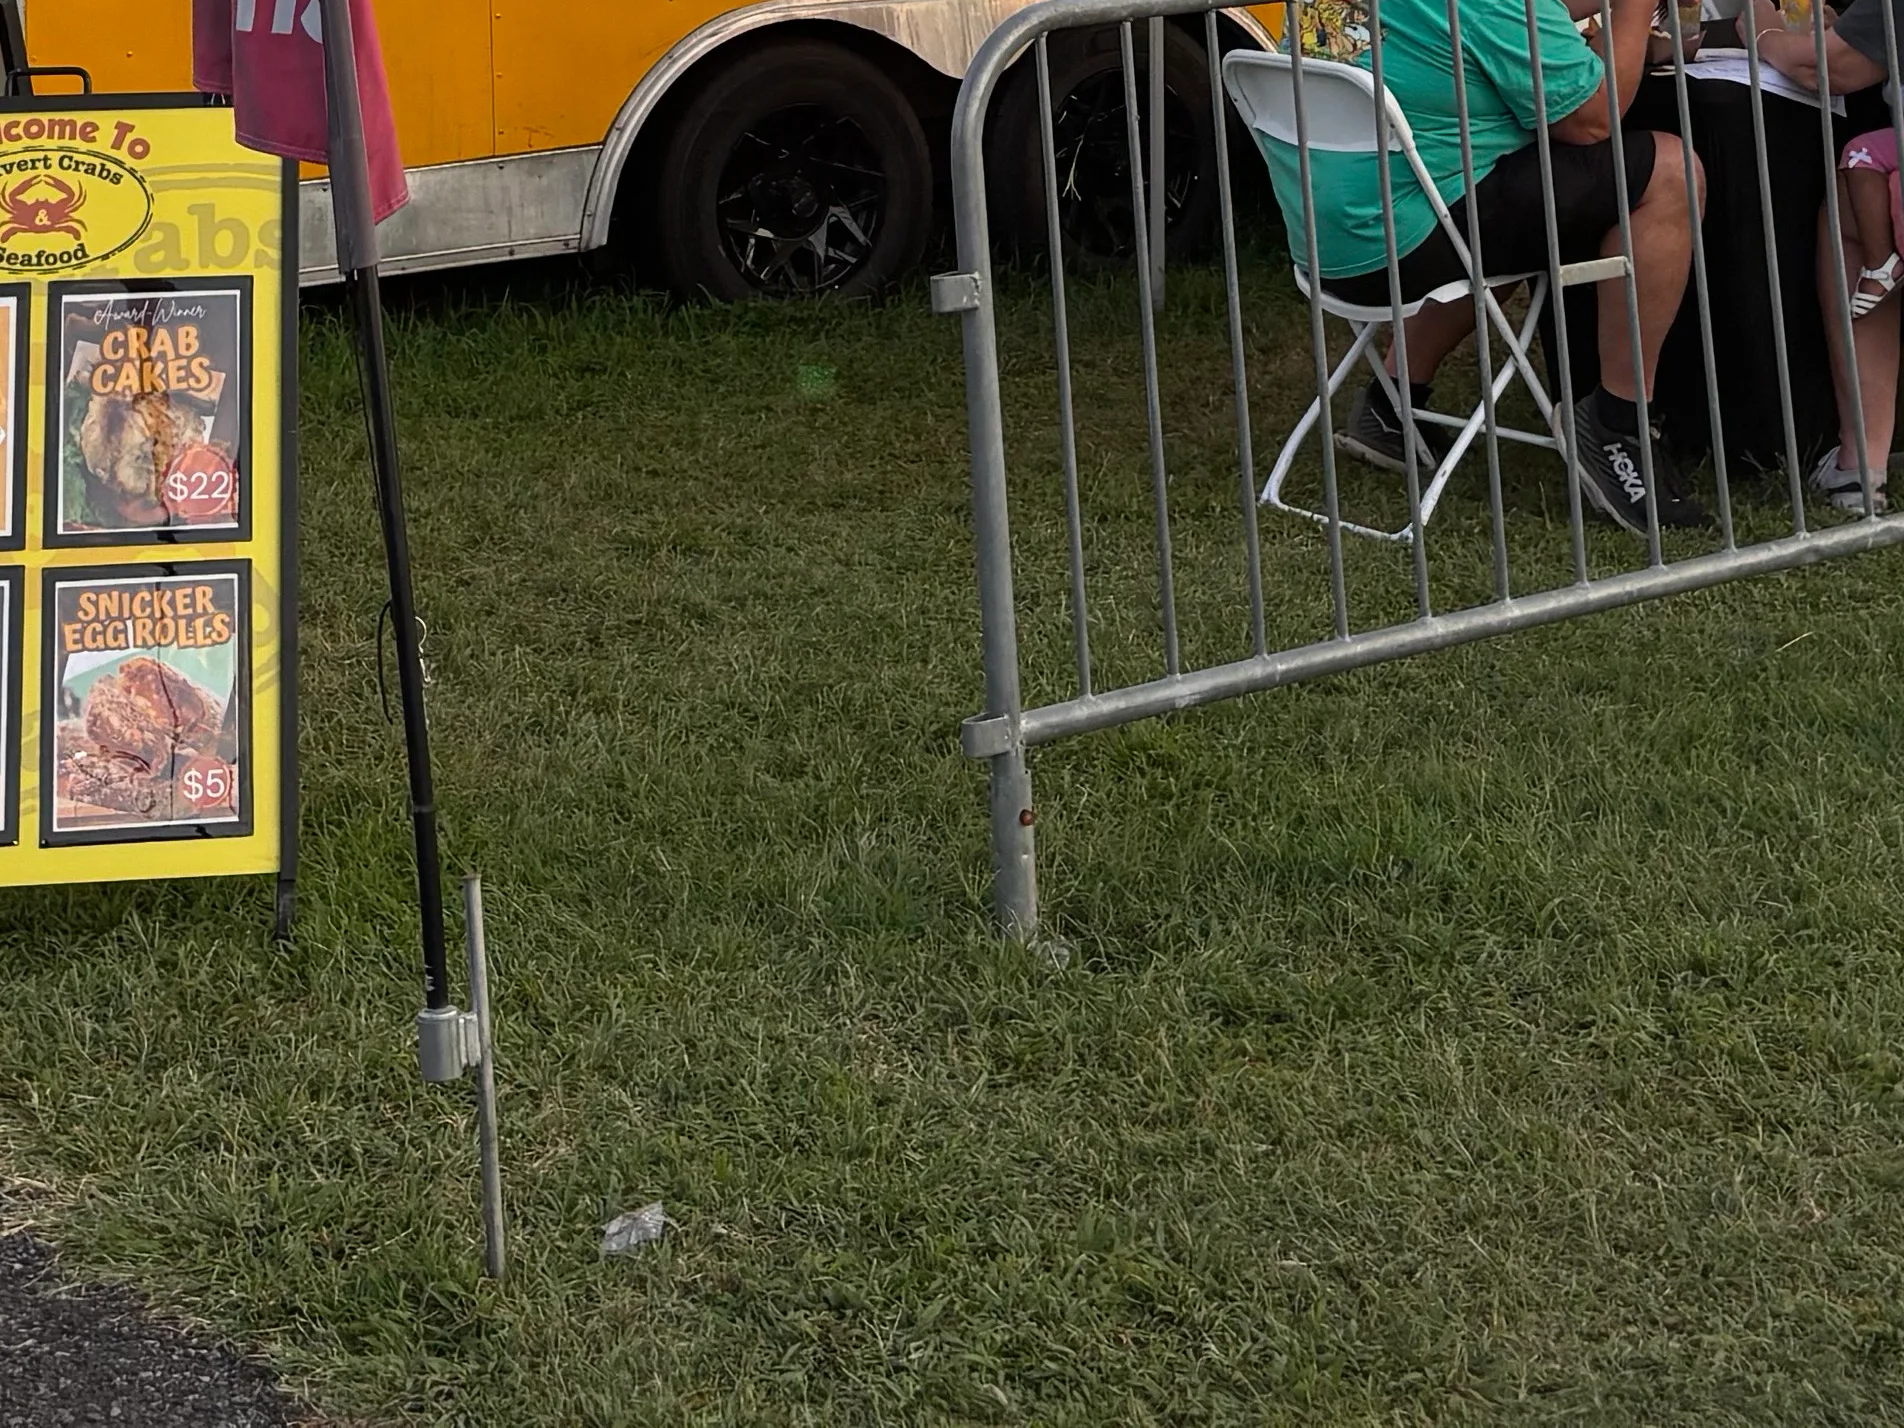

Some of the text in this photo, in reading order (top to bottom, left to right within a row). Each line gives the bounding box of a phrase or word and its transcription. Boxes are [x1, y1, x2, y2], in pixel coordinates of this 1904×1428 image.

[110, 120, 152, 160] To
[57, 155, 124, 187] Crabs
[35, 208, 50, 227] &
[102, 325, 201, 361] CRAB
[91, 357, 213, 395] CAKES
[167, 470, 231, 503] $22
[76, 585, 216, 623] SNICKER
[62, 613, 233, 653] EGG ROLLS
[182, 768, 226, 801] $5
